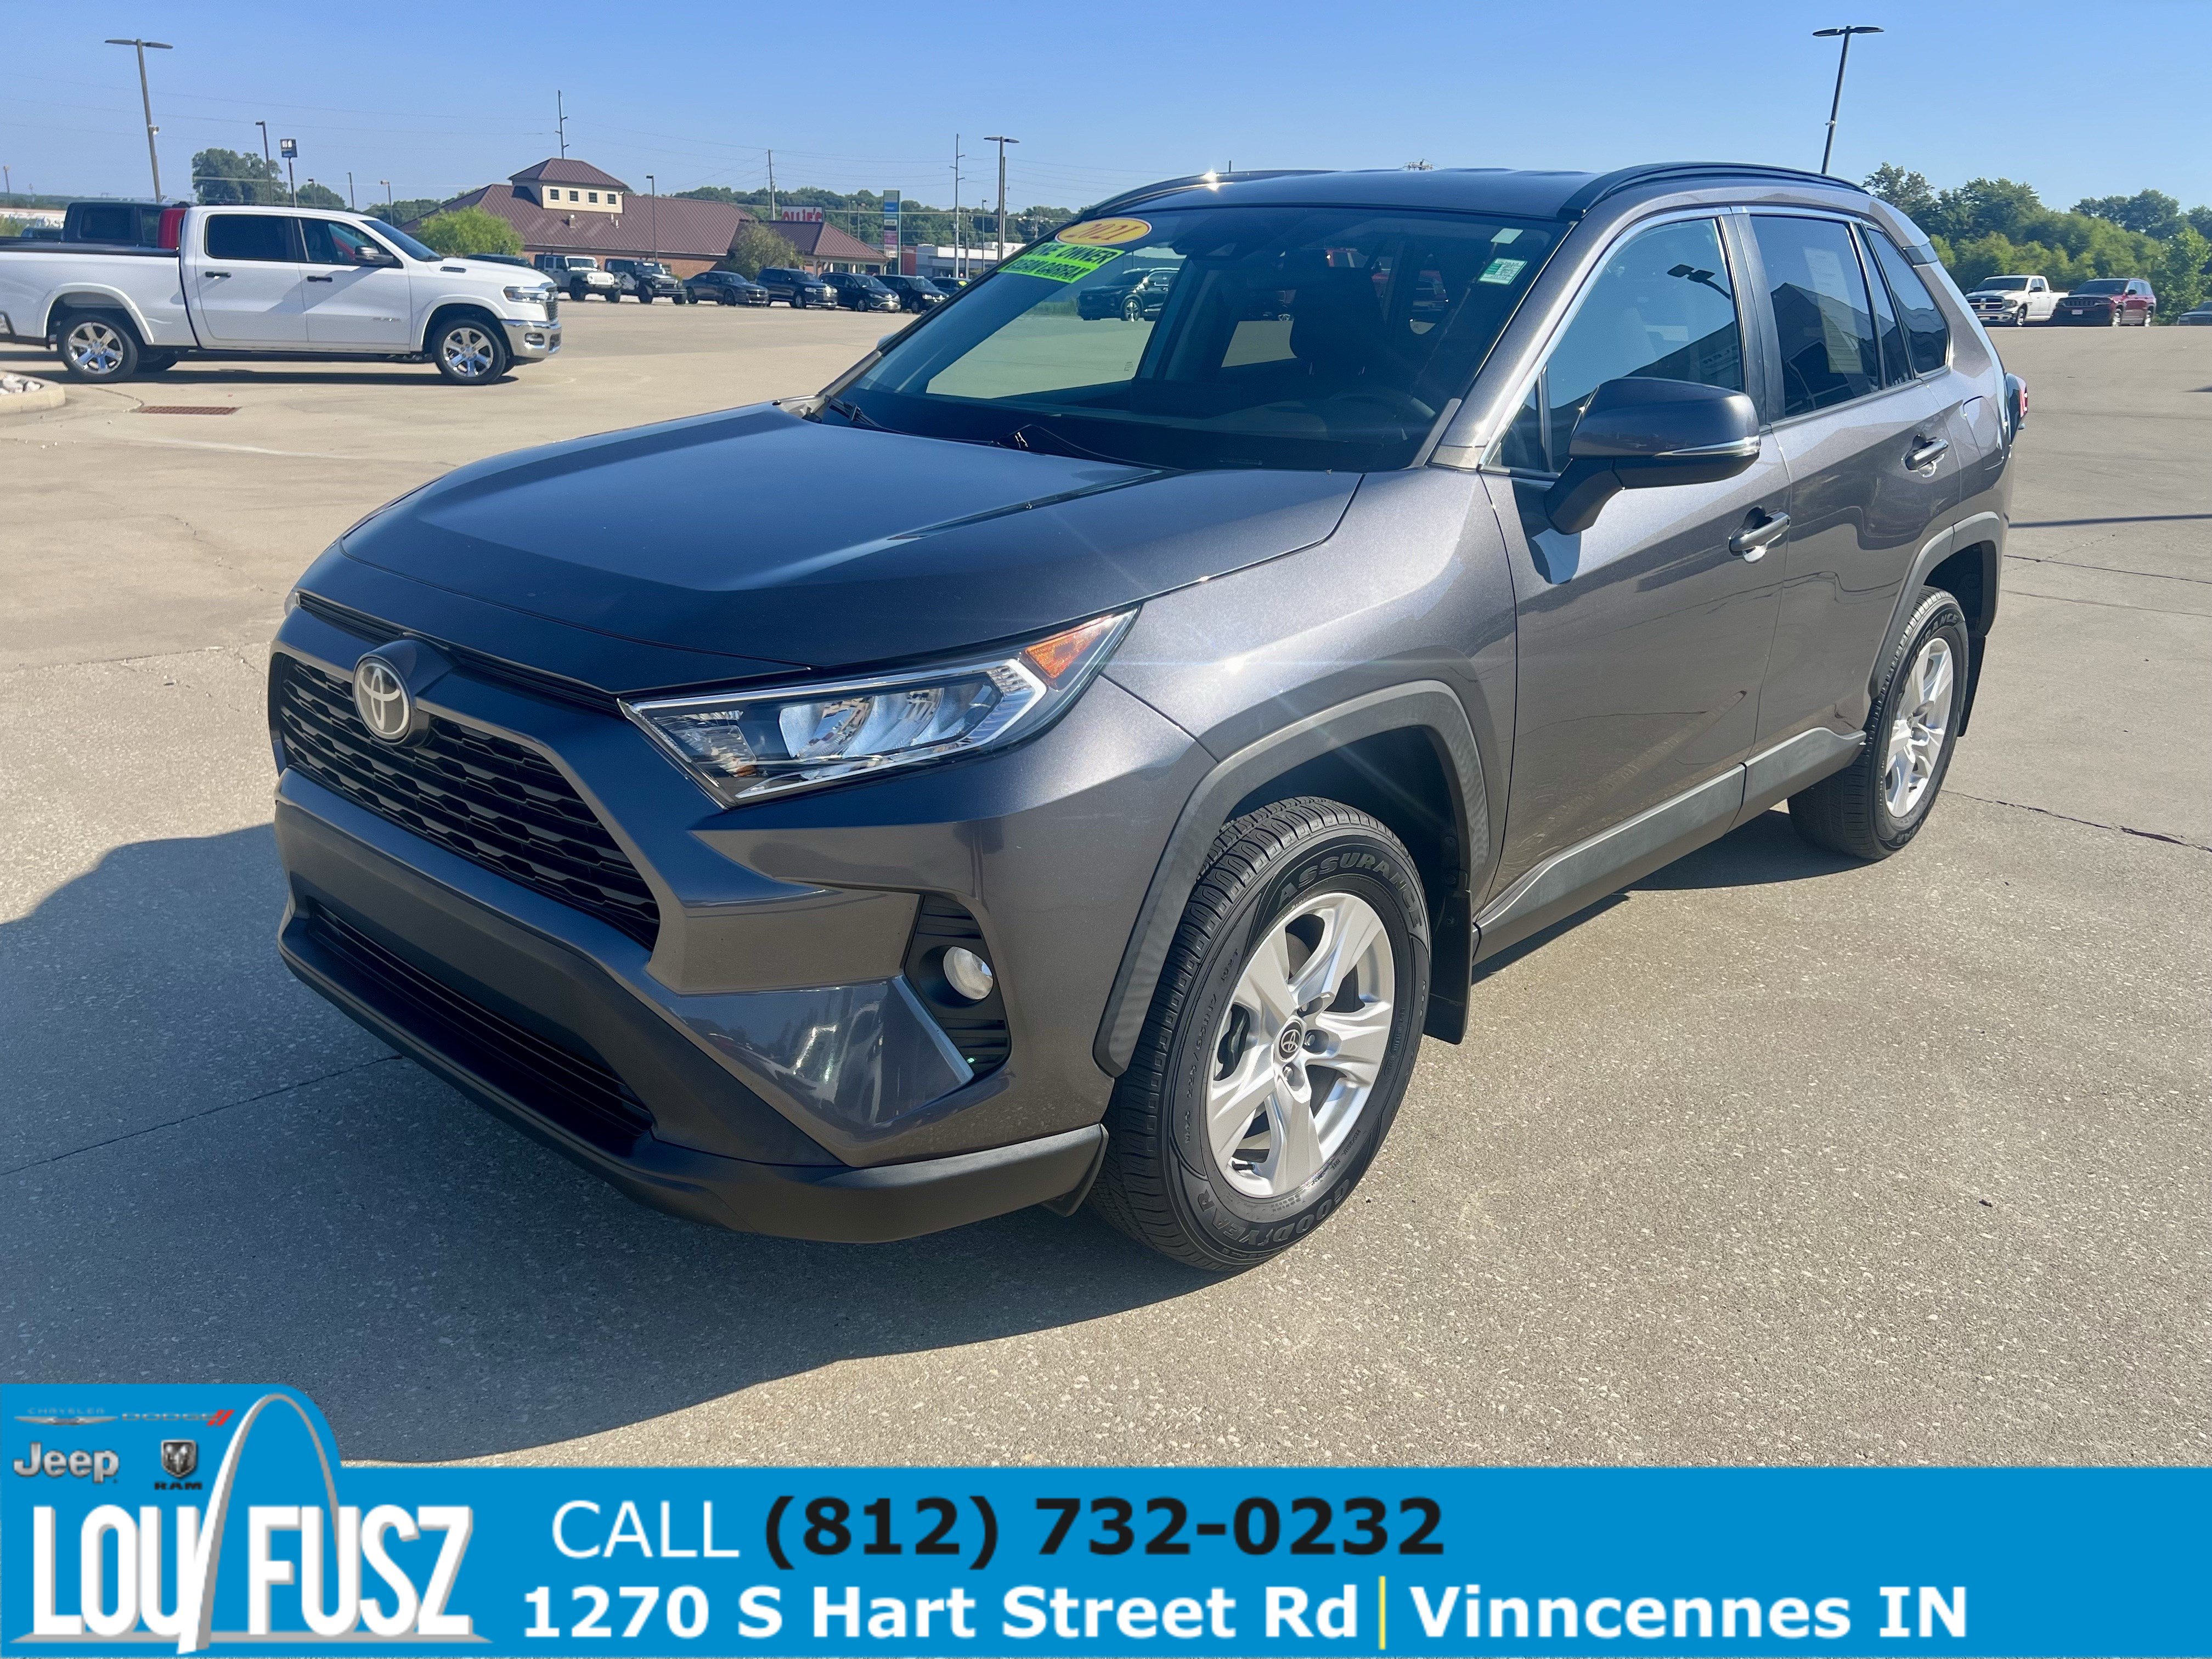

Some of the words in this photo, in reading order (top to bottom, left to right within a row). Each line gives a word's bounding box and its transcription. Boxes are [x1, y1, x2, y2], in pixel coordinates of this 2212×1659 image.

[1034, 262, 1092, 281] CARFAX
[1056, 246, 1118, 264] OWNER
[1277, 853, 1423, 929] ASSURANCE
[1186, 993, 1217, 1098] 225/65R17
[1221, 948, 1239, 984] 102T
[1197, 1179, 1351, 1246] GOODYEAR
